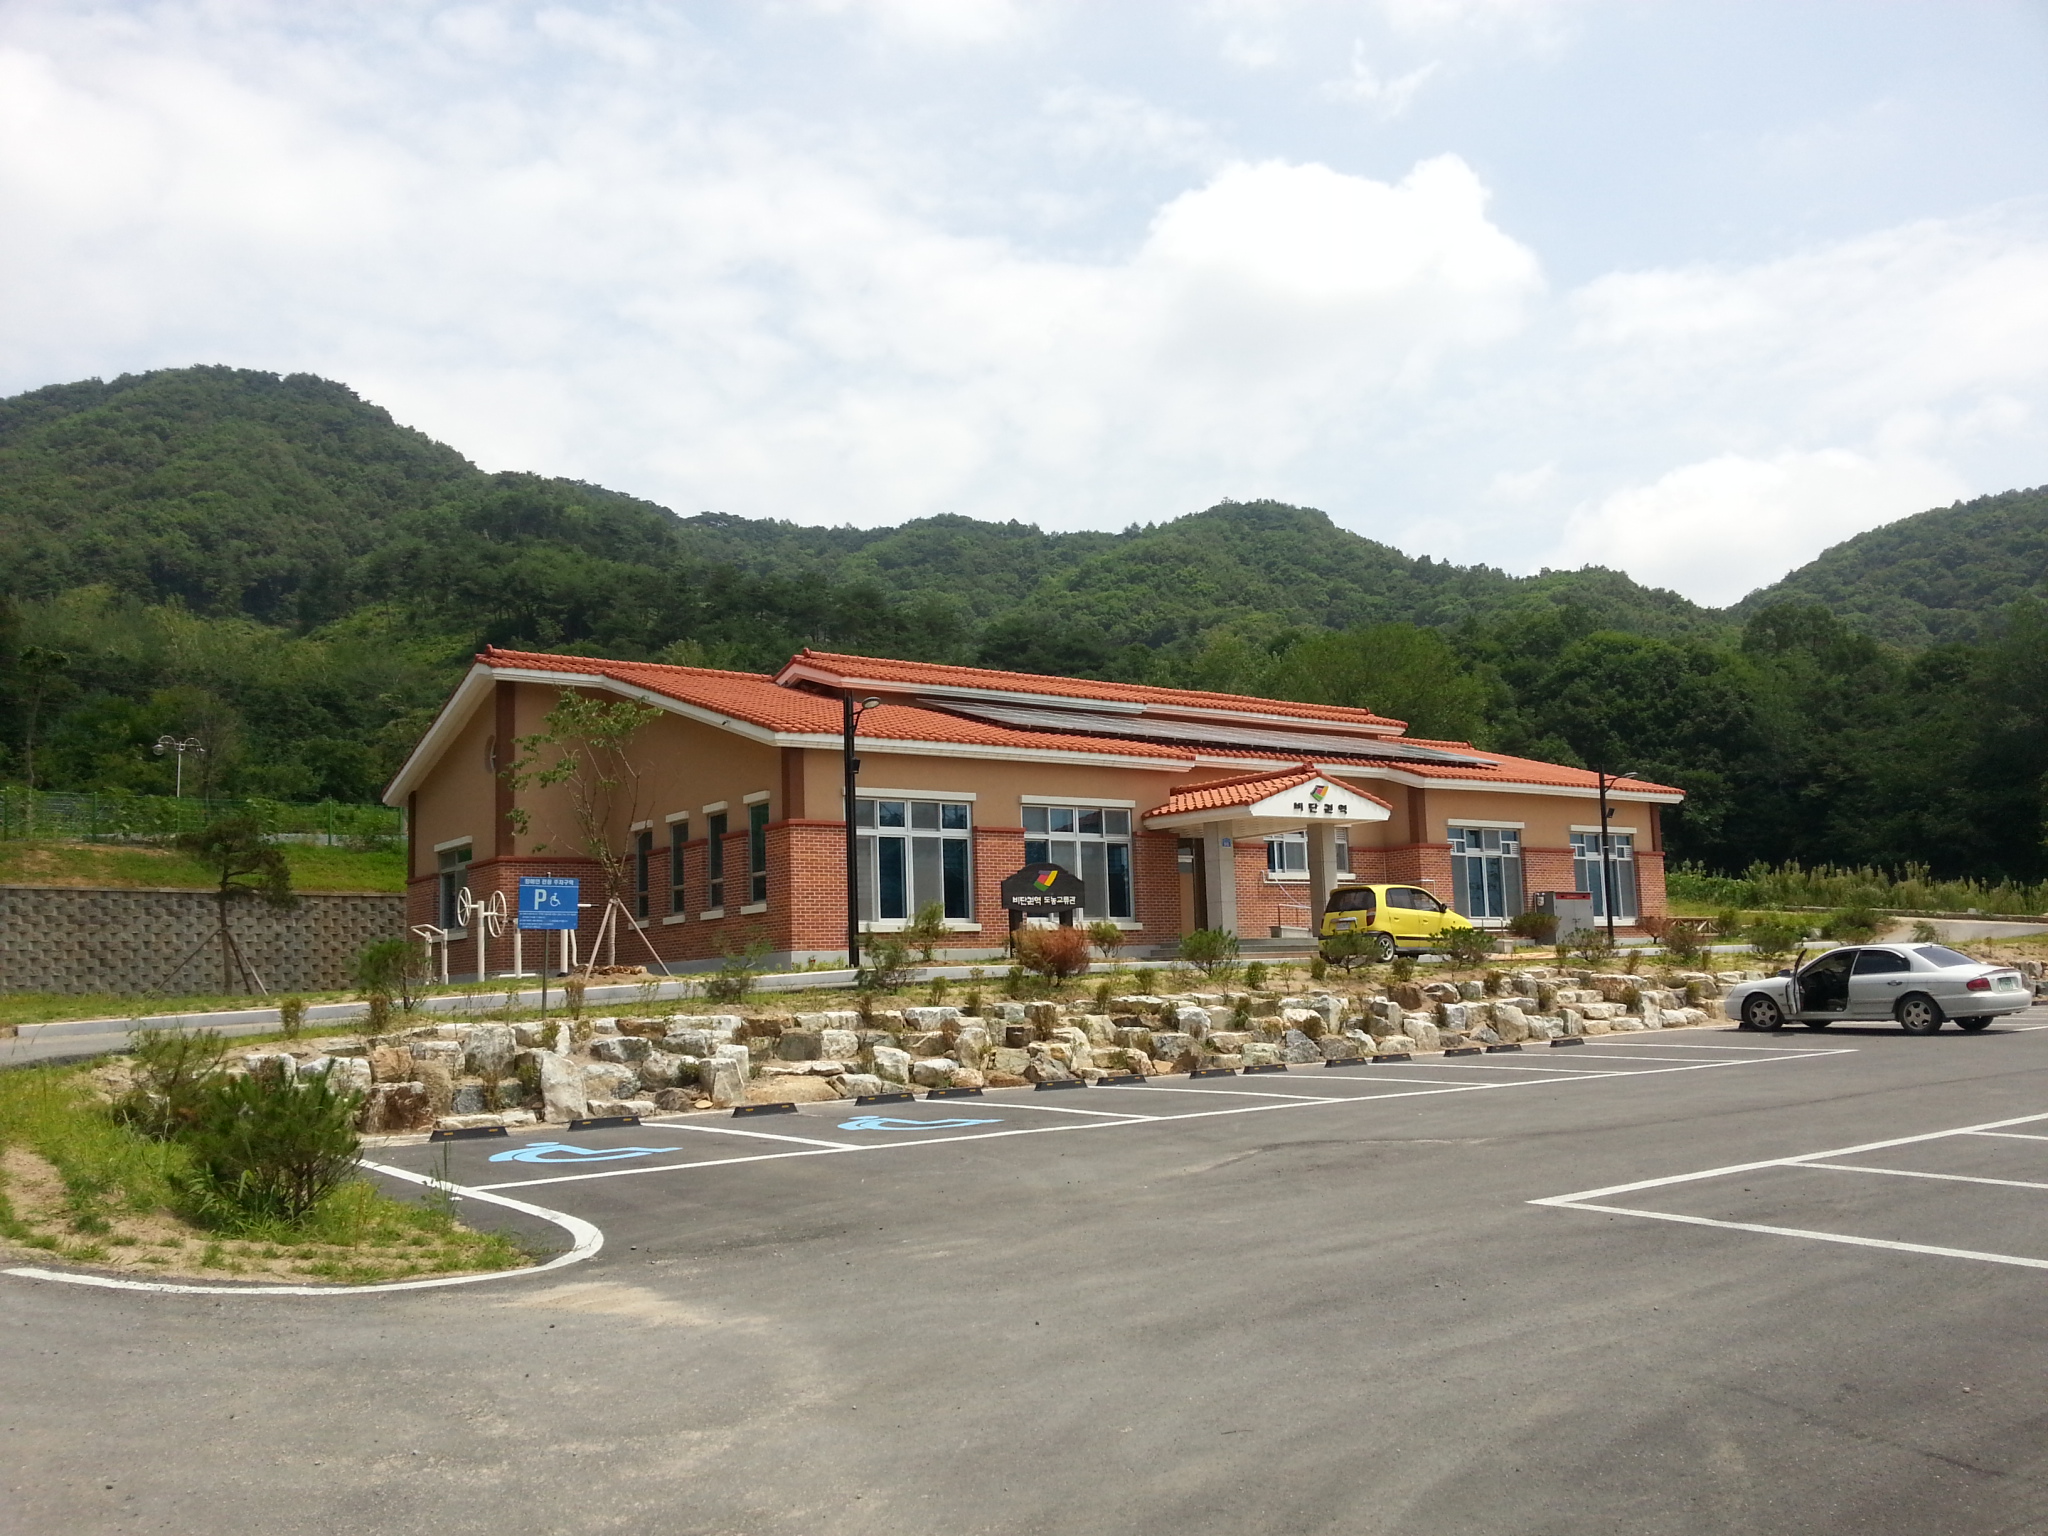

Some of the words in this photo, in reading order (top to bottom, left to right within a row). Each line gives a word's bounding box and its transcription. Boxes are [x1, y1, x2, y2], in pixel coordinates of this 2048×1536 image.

[1293, 802, 1348, 814] 비단권역
[534, 888, 547, 910] P
[1012, 896, 1042, 906] 비단권역
